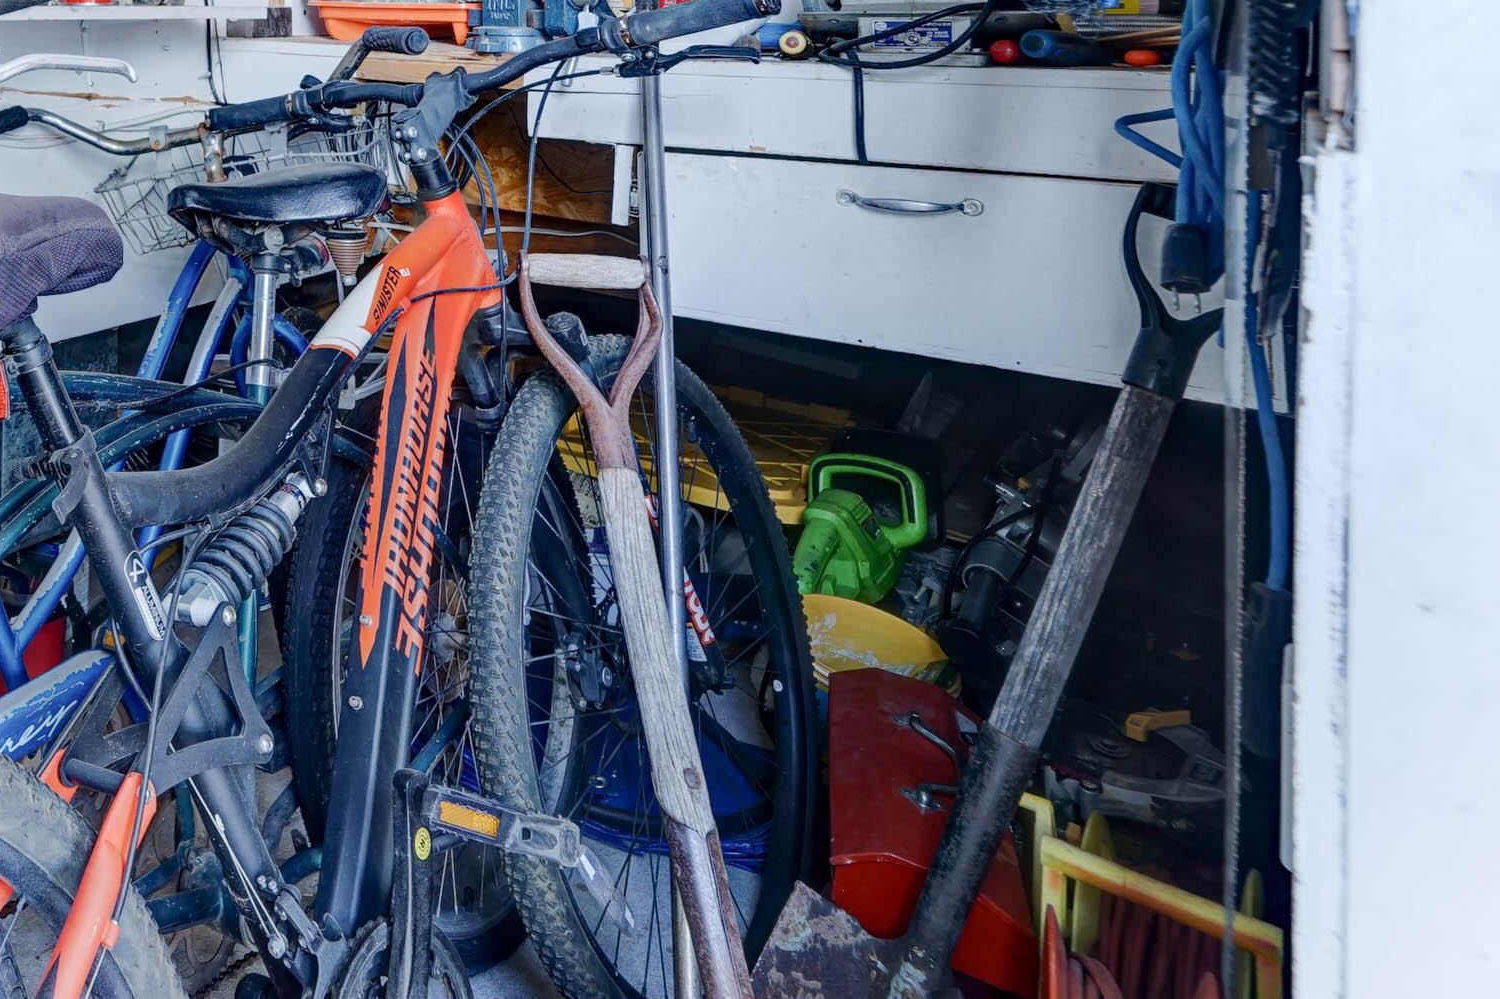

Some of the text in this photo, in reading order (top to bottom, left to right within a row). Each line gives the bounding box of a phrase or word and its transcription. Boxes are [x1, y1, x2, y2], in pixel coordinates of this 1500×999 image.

[373, 265, 401, 327] SINISTER
[384, 349, 439, 600] IRONHORSE
[129, 558, 145, 583] 4
